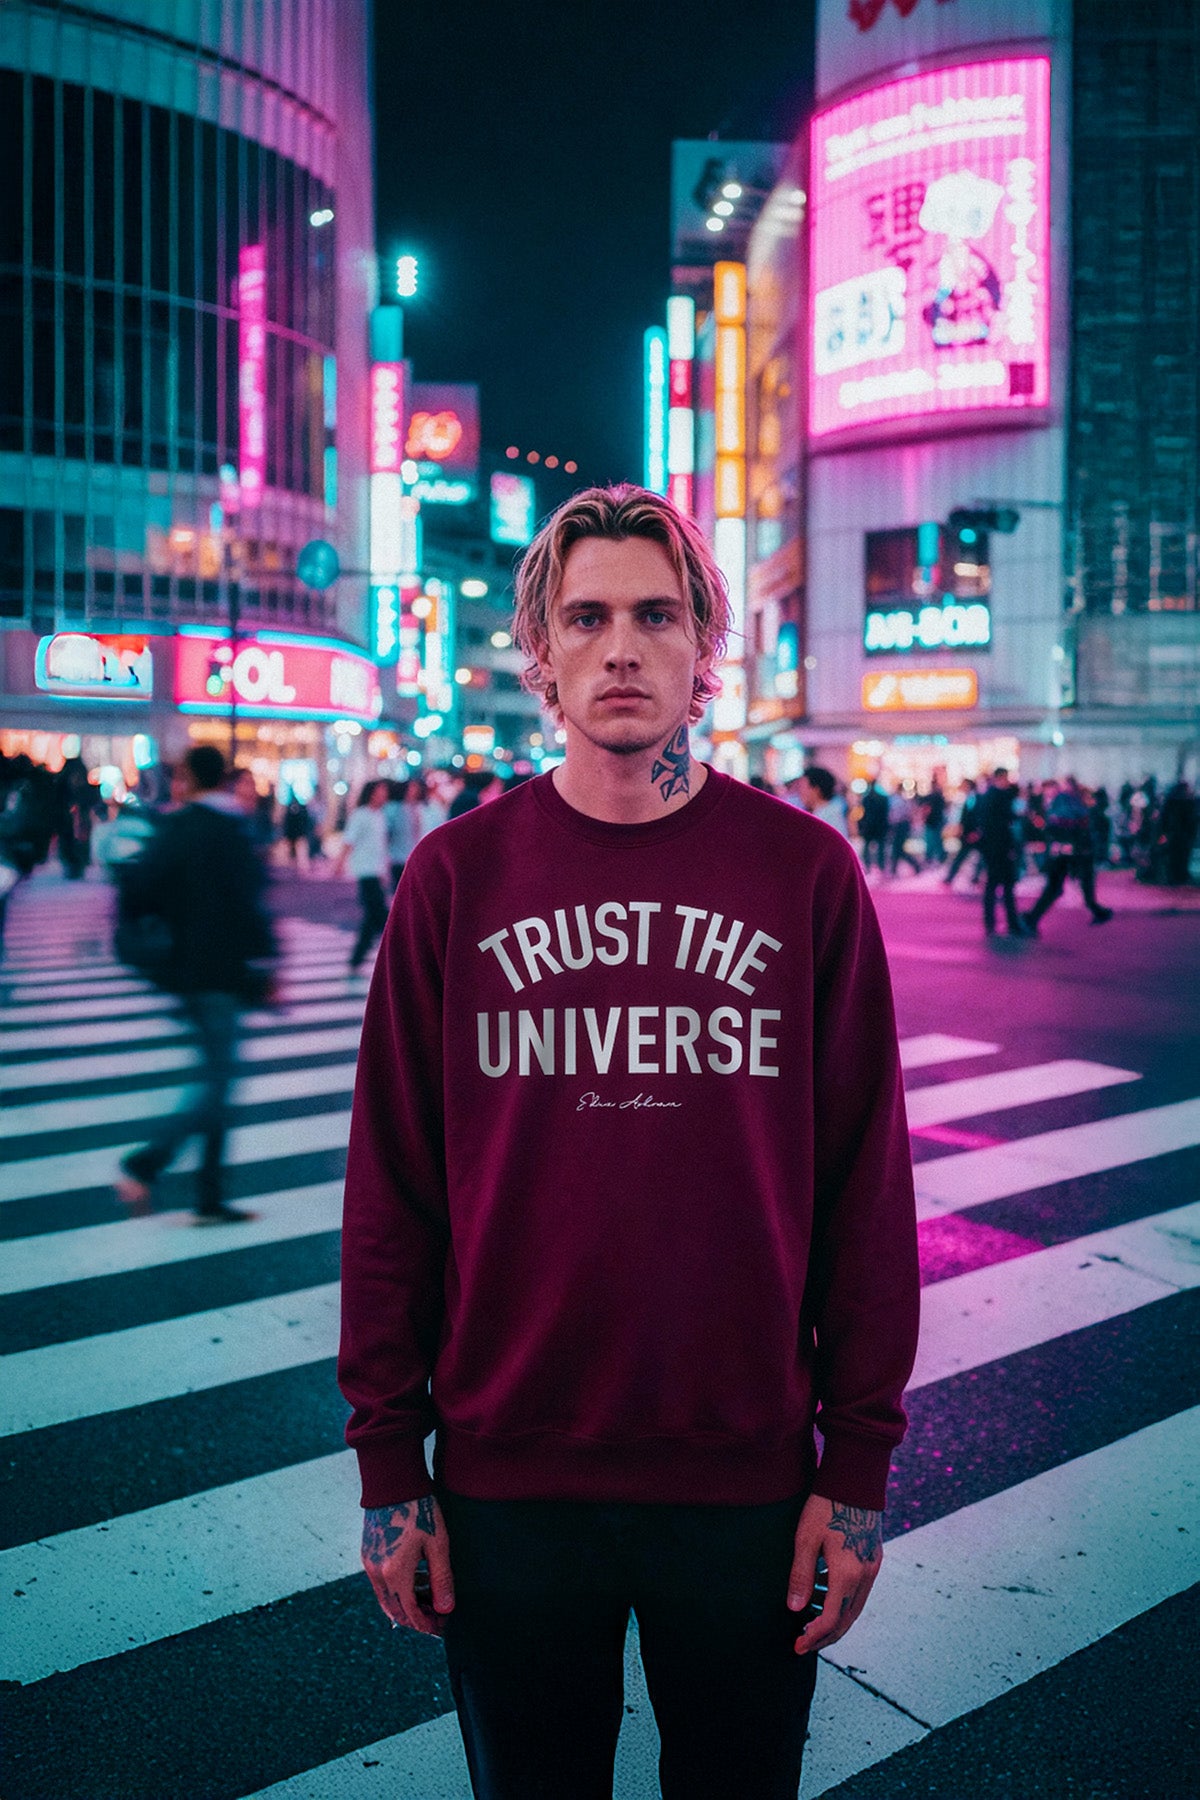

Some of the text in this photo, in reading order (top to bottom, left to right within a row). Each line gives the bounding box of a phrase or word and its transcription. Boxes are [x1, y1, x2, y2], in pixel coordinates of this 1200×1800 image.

[477, 901, 784, 997] TRUST THE
[476, 1005, 782, 1078] UNIVERSE
